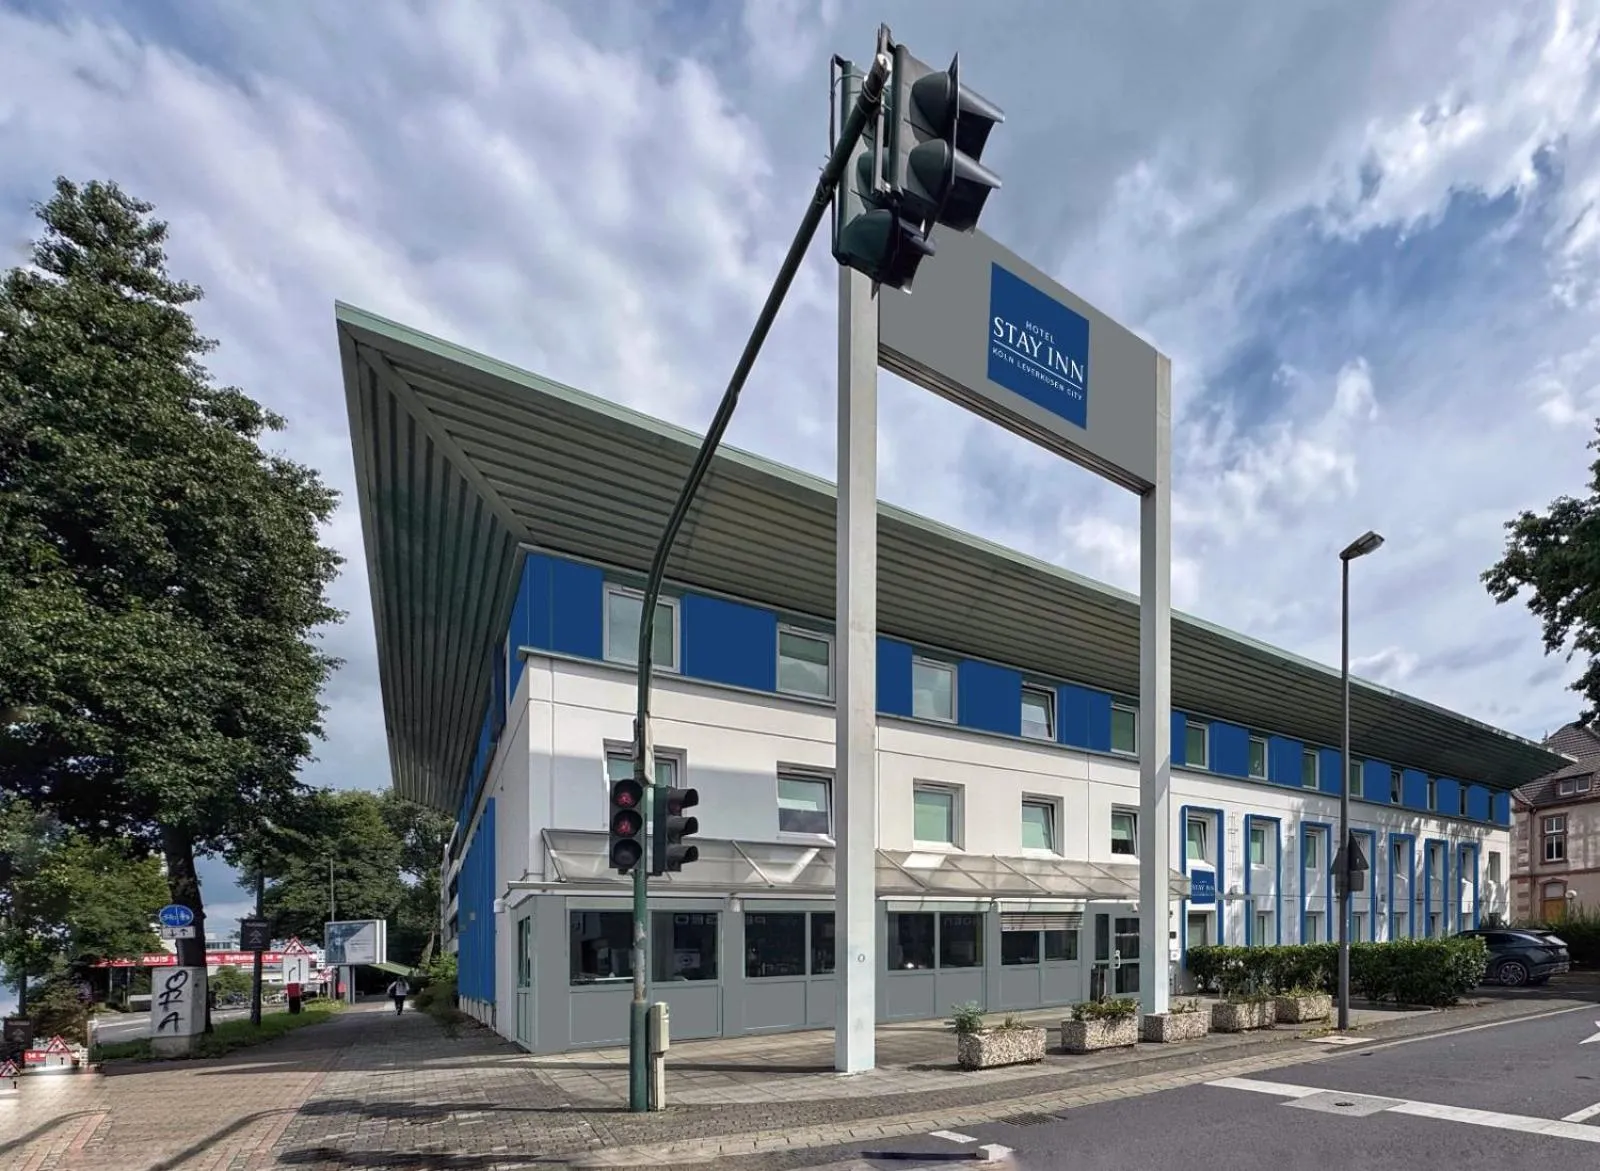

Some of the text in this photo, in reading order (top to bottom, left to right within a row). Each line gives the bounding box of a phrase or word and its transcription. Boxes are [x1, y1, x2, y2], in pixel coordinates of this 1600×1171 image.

[993, 316, 1084, 383] STAY INN
[1026, 320, 1055, 344] HOTEL
[1017, 361, 1064, 391] LEVERKUSEN
[1067, 389, 1082, 400] CITY
